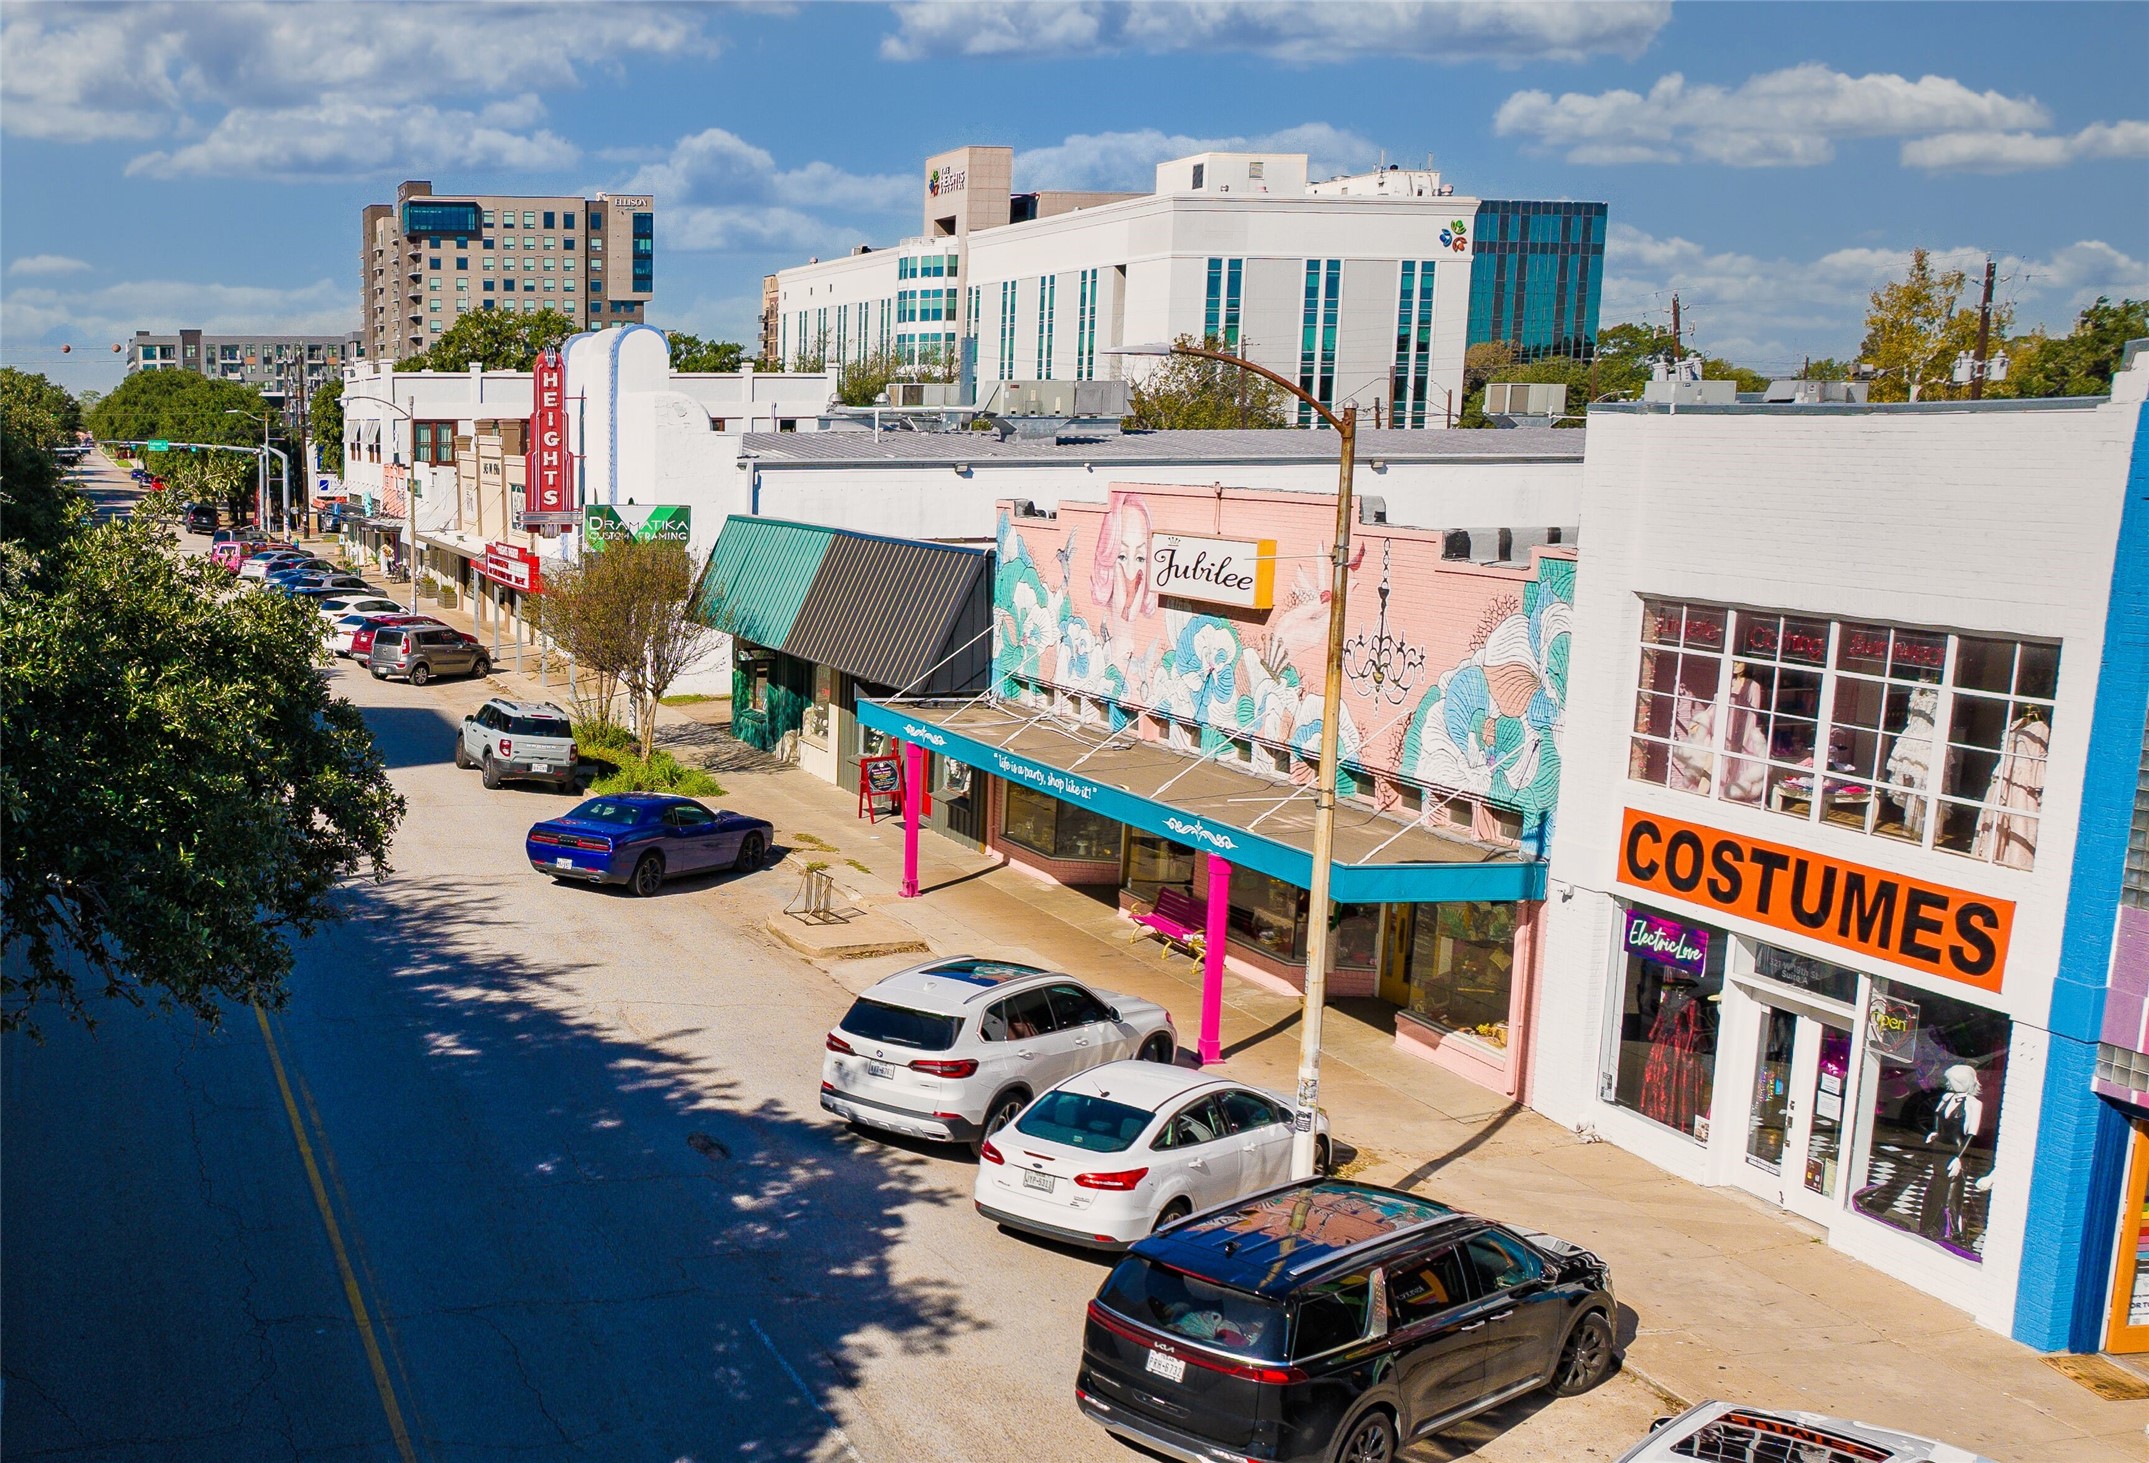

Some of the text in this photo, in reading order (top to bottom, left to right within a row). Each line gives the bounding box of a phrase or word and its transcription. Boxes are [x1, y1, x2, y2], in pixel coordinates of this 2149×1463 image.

[615, 198, 647, 206] ELLISON
[543, 372, 561, 506] HEIGHTS
[589, 516, 689, 530] DRAMATIKA
[638, 531, 687, 540] FRAMING
[1154, 548, 1253, 590] Jubilee
[1048, 773, 1065, 793] shop
[1065, 778, 1080, 795] like
[1627, 820, 2000, 977] COSTUMES
[1781, 970, 1799, 981] Suite
